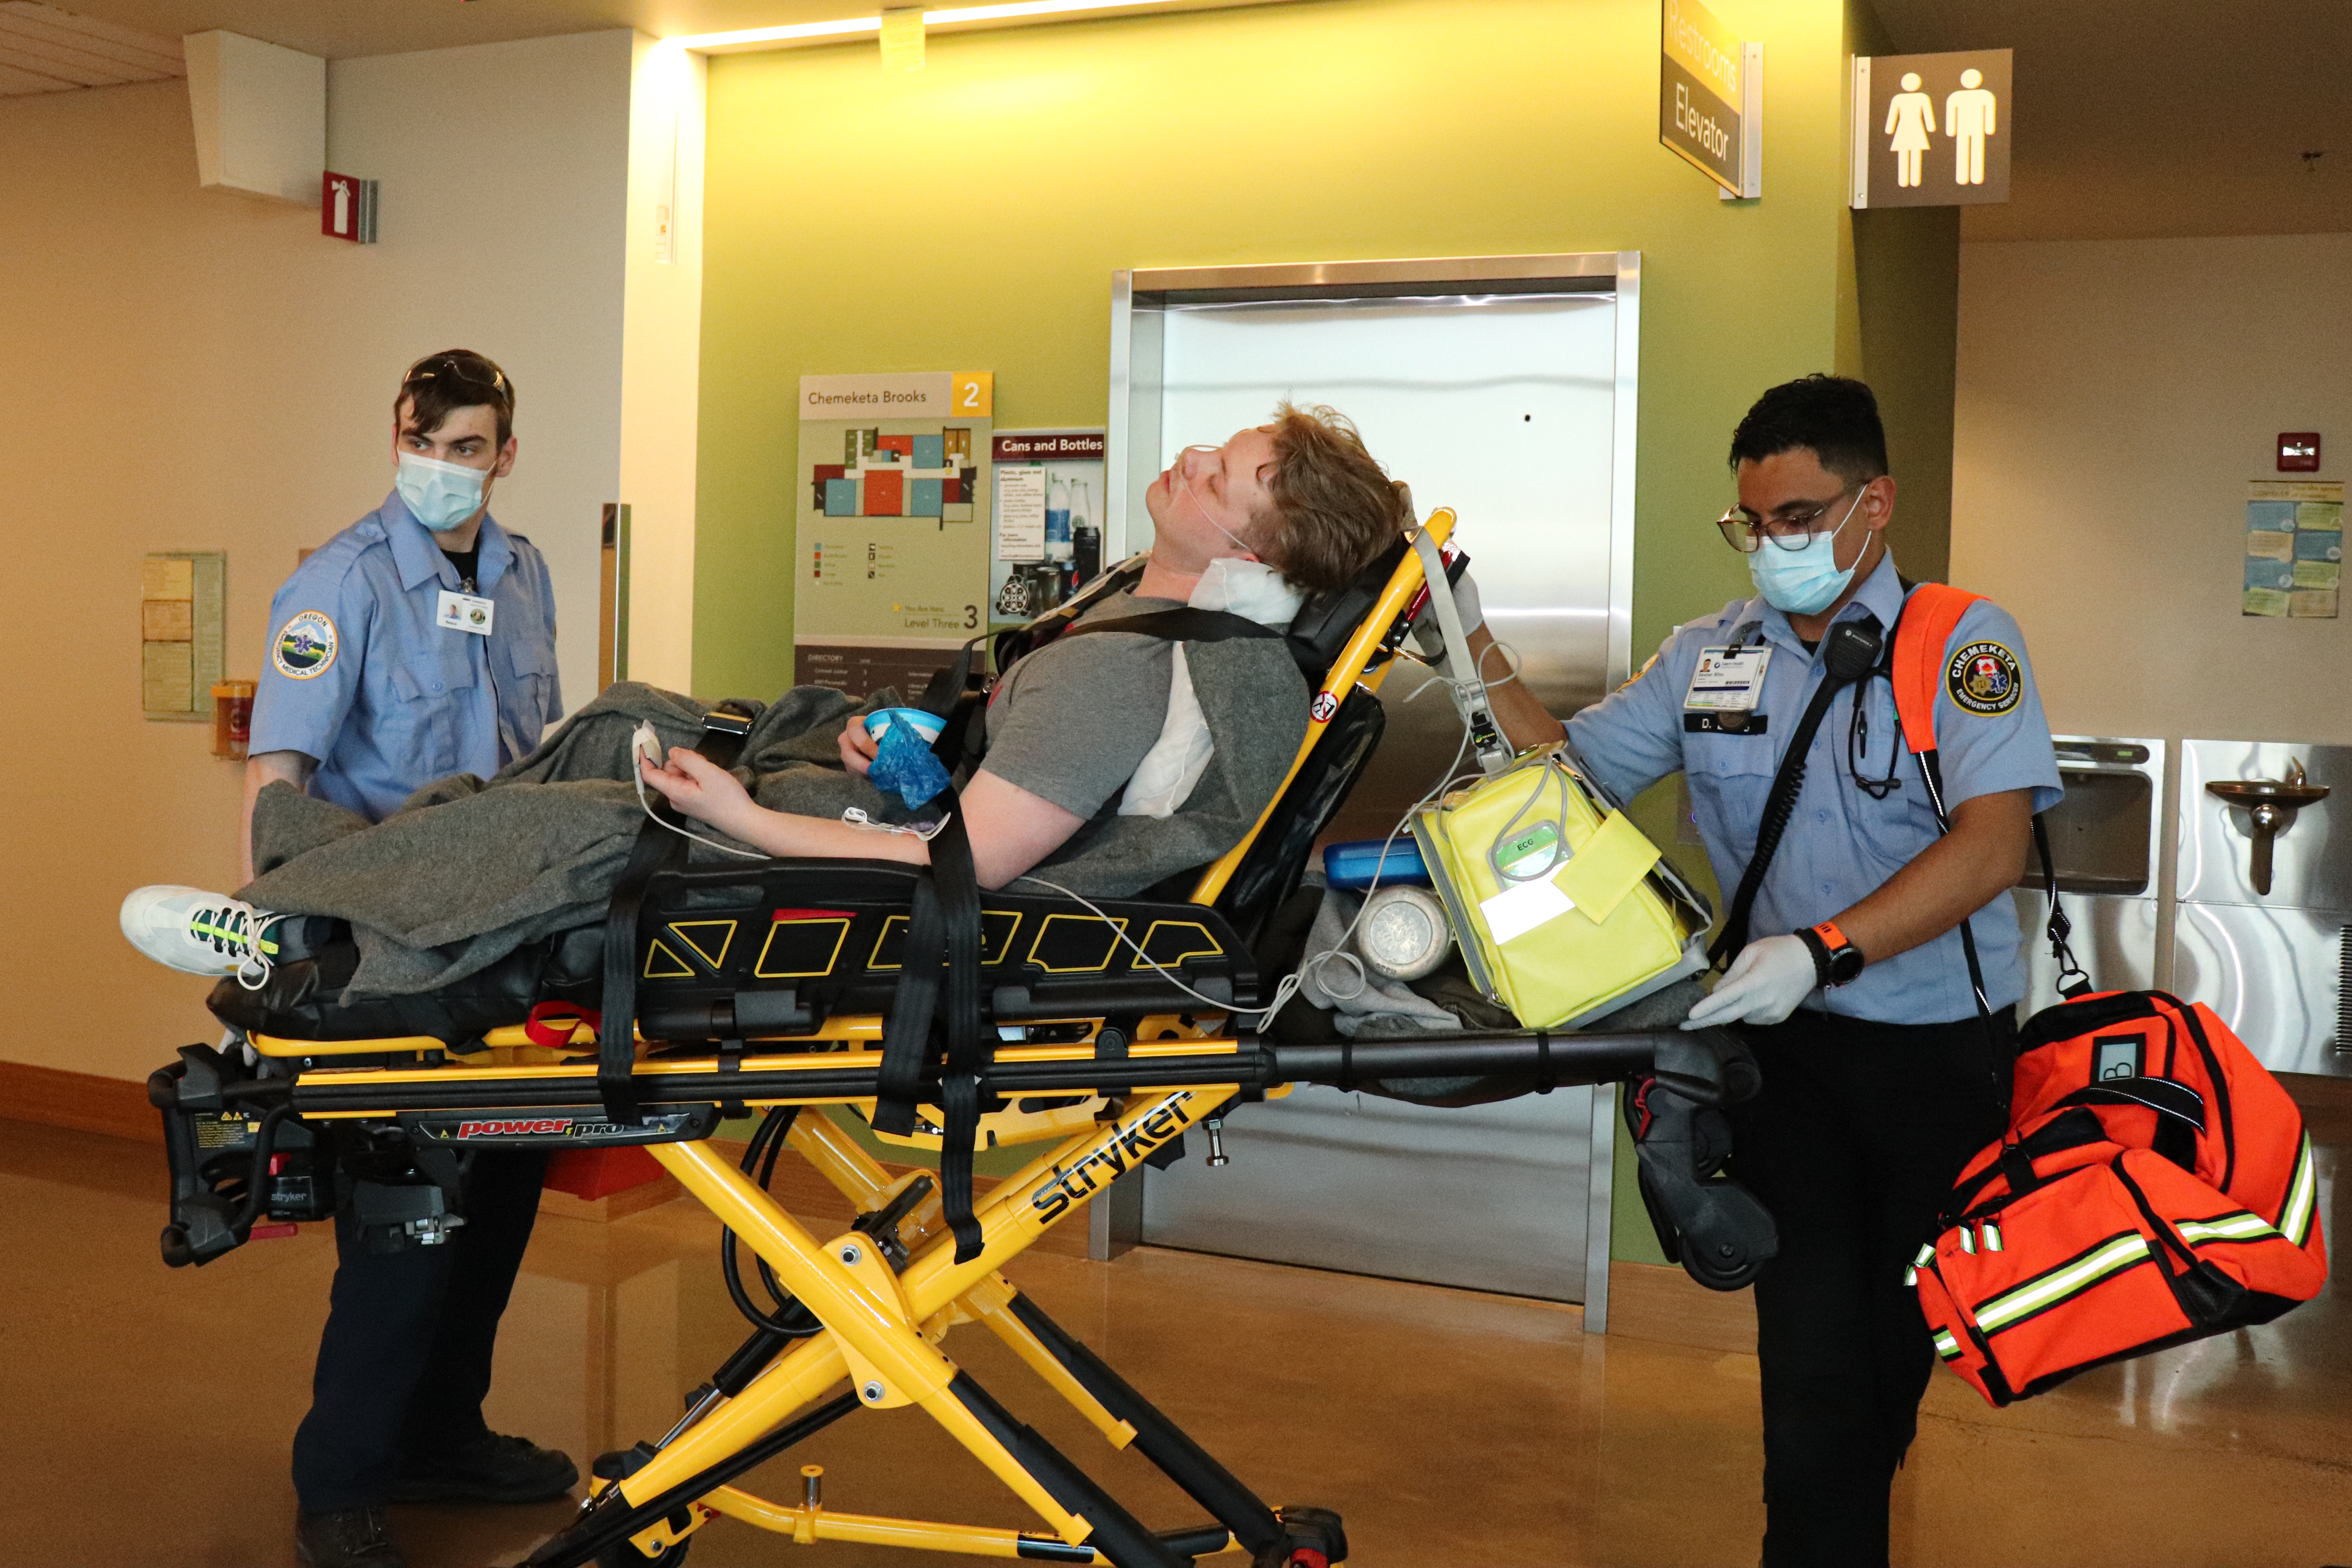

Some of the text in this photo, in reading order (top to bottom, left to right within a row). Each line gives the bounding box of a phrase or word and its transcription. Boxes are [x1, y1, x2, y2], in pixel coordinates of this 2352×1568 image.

[1669, 0, 1737, 93] Restrooms
[1676, 82, 1729, 161] Elevator
[809, 390, 926, 404] Chemeketa Brooks
[964, 383, 979, 407] 2
[1002, 438, 1103, 452] Cans and Bottles
[299, 613, 328, 627] OREGON
[904, 618, 960, 629] Level Three
[964, 605, 978, 629] 3
[282, 664, 308, 675] MEDICAL
[309, 642, 334, 674] TECHNICIAN
[1952, 644, 2017, 678] CHEMEKETA
[1956, 688, 1996, 711] EMERGENCY
[1702, 718, 1711, 729] D.
[1517, 839, 1534, 850] ECG
[457, 1118, 624, 1140] power pro
[1031, 1090, 1193, 1225] stryker
[271, 1192, 307, 1202] stryker
